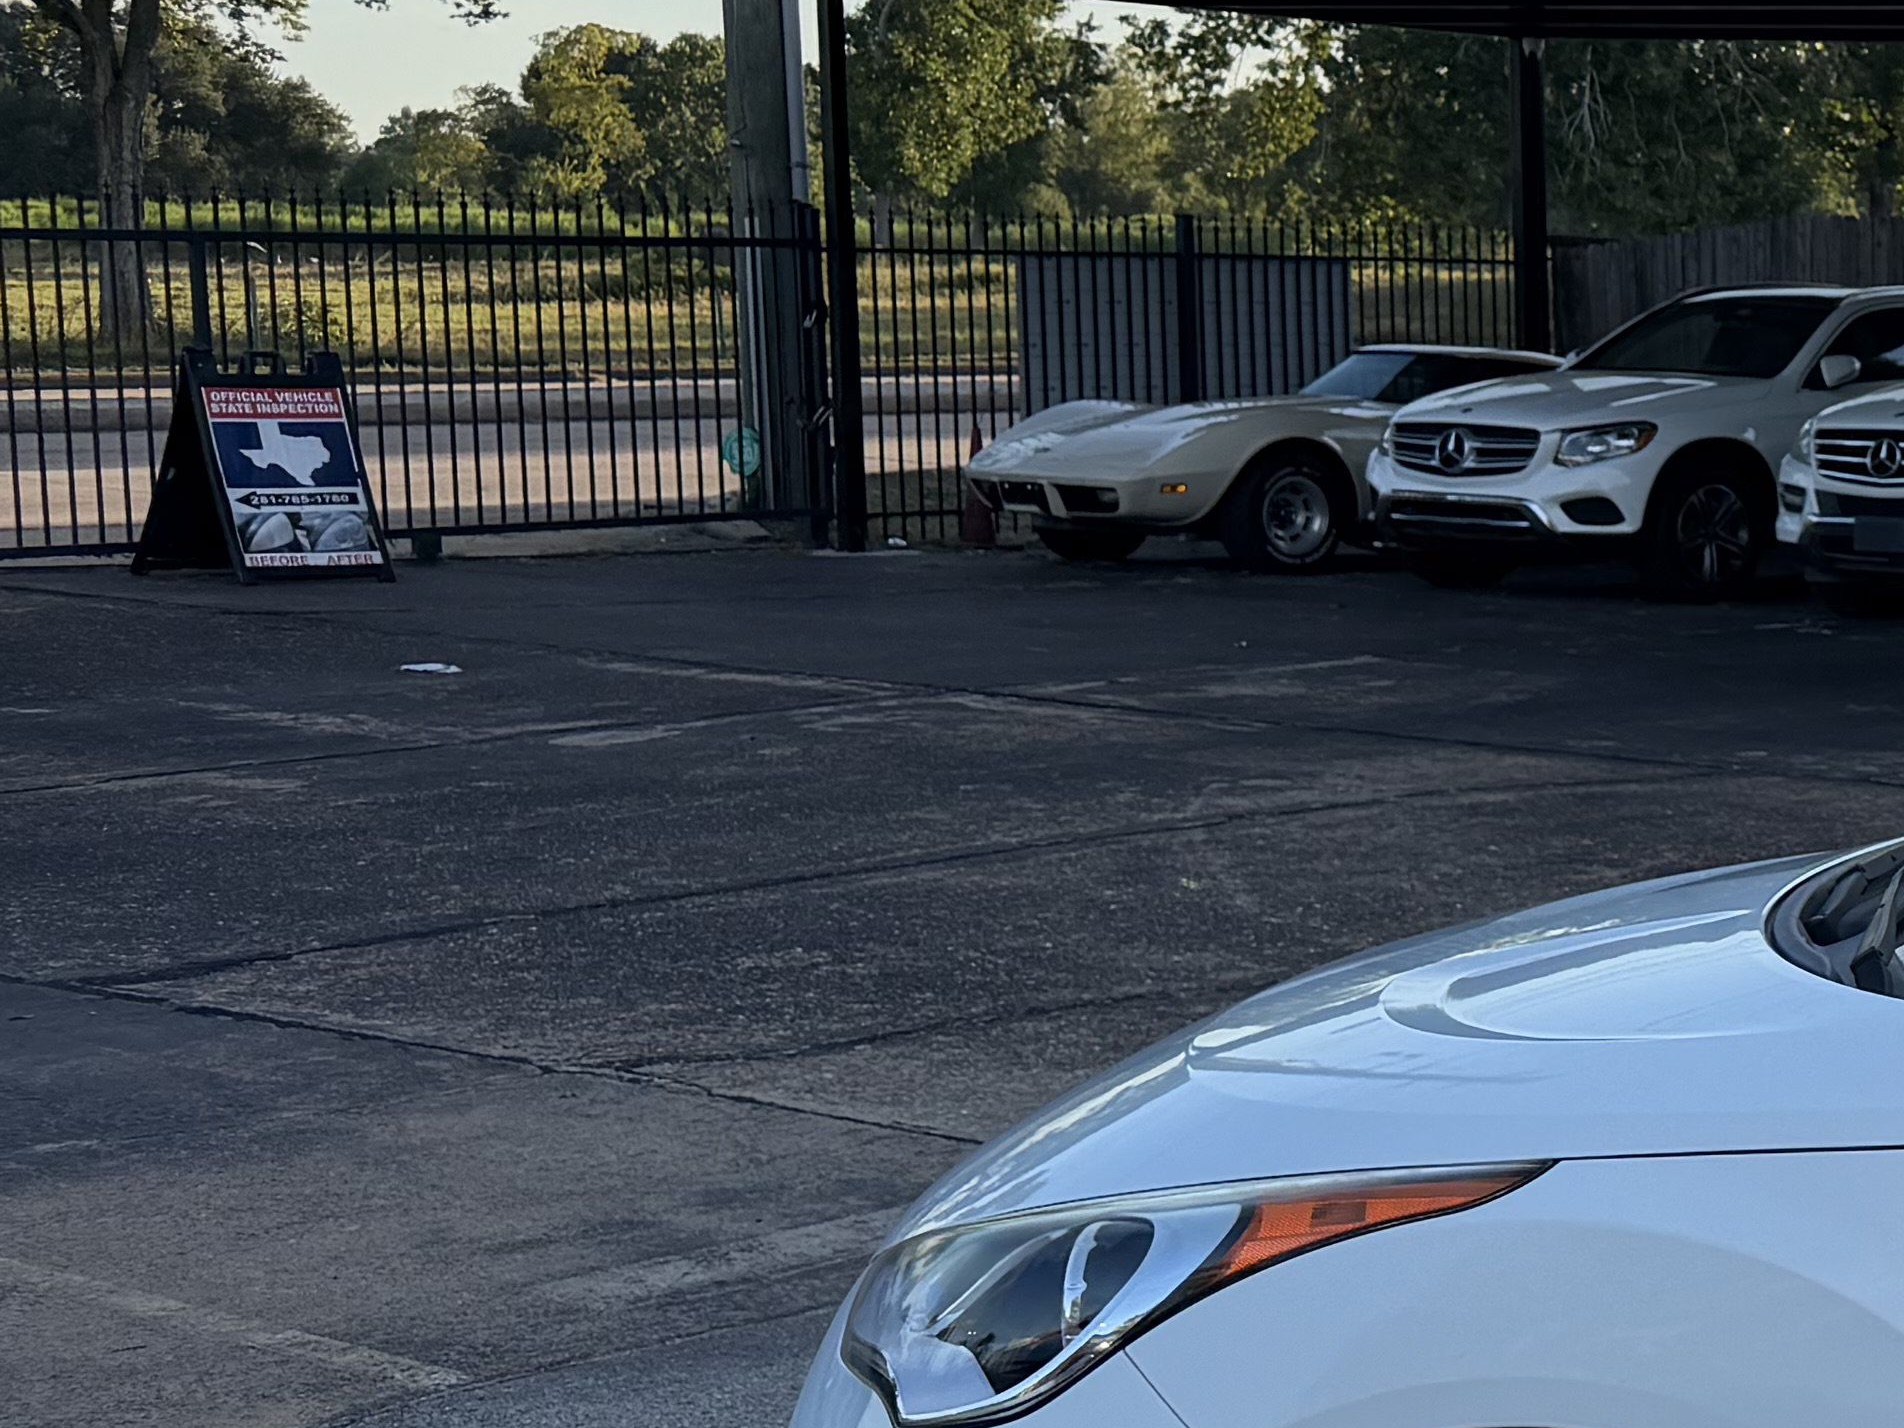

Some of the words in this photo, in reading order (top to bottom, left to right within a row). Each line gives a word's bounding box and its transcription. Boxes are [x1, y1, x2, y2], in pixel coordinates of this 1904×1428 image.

[210, 391, 273, 402] OFFICIAL
[274, 391, 334, 402] VEHICLE
[210, 402, 253, 413] STATE
[256, 402, 339, 413] INSPECTION
[249, 555, 309, 567] BEFORE
[327, 554, 374, 566] AFTER
